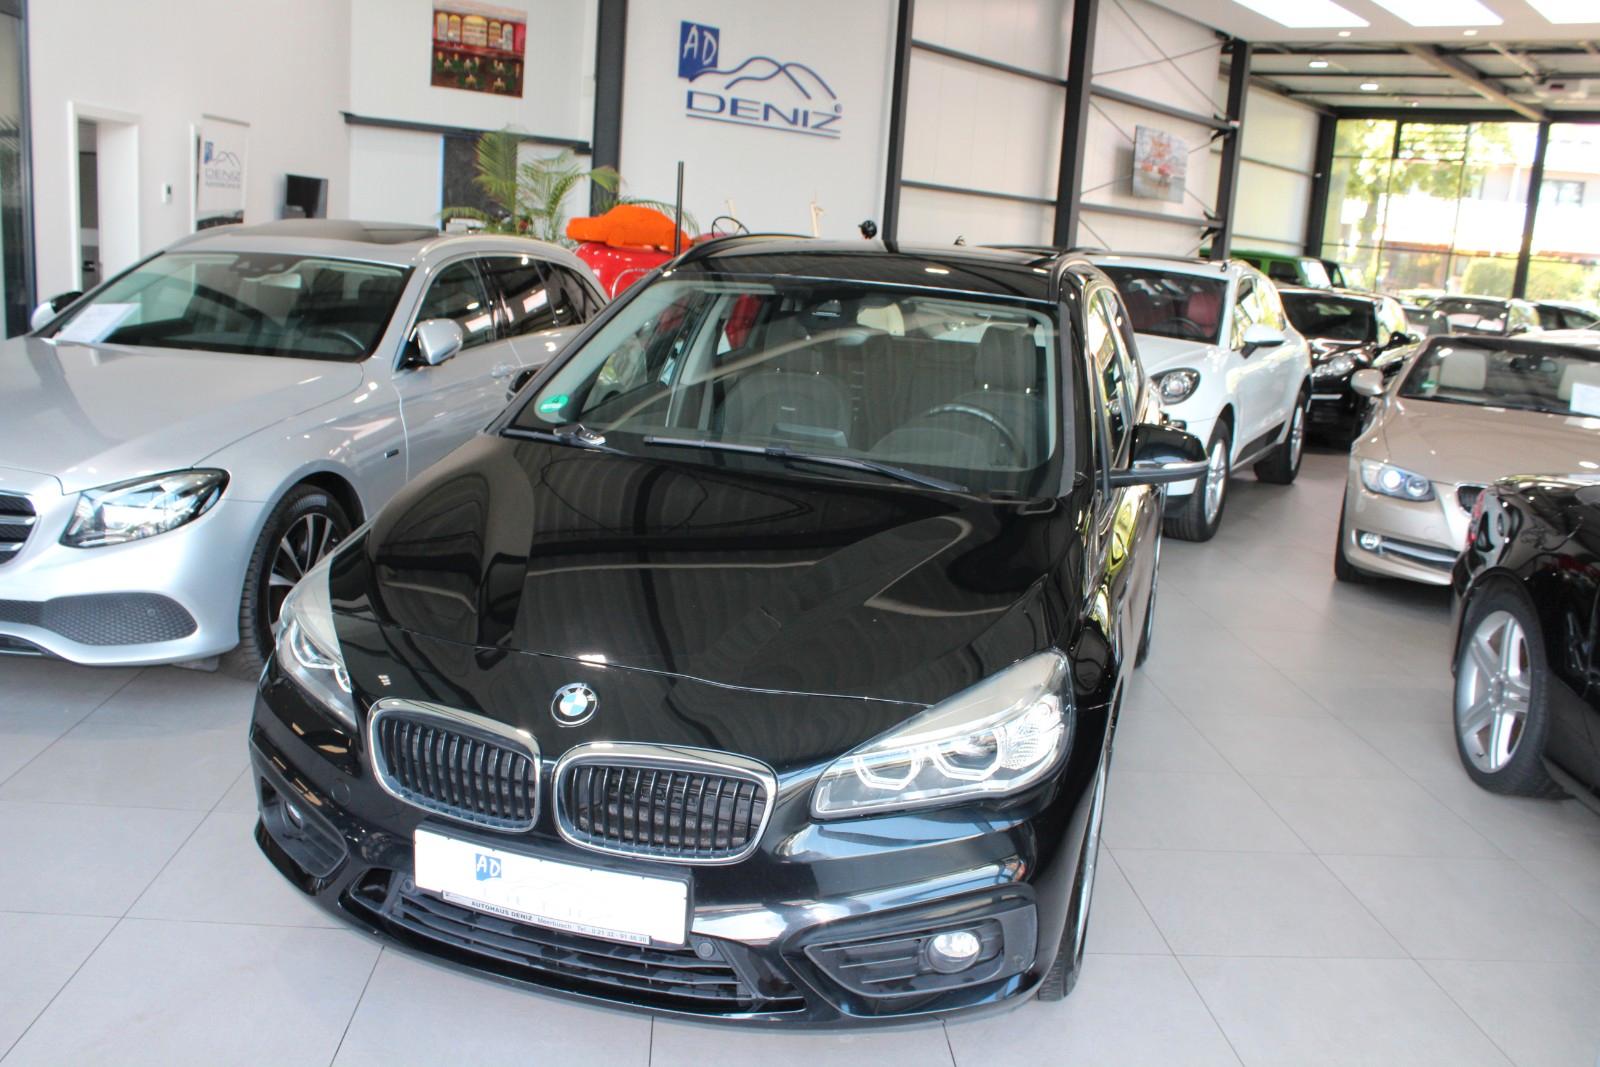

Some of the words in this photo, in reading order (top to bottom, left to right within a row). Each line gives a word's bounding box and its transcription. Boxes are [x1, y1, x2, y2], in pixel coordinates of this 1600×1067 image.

[683, 25, 717, 66] AD
[686, 90, 842, 133] DENIZ
[477, 853, 501, 878] AD
[471, 901, 509, 915] AUTOHAUS
[511, 911, 533, 921] DENIZ
